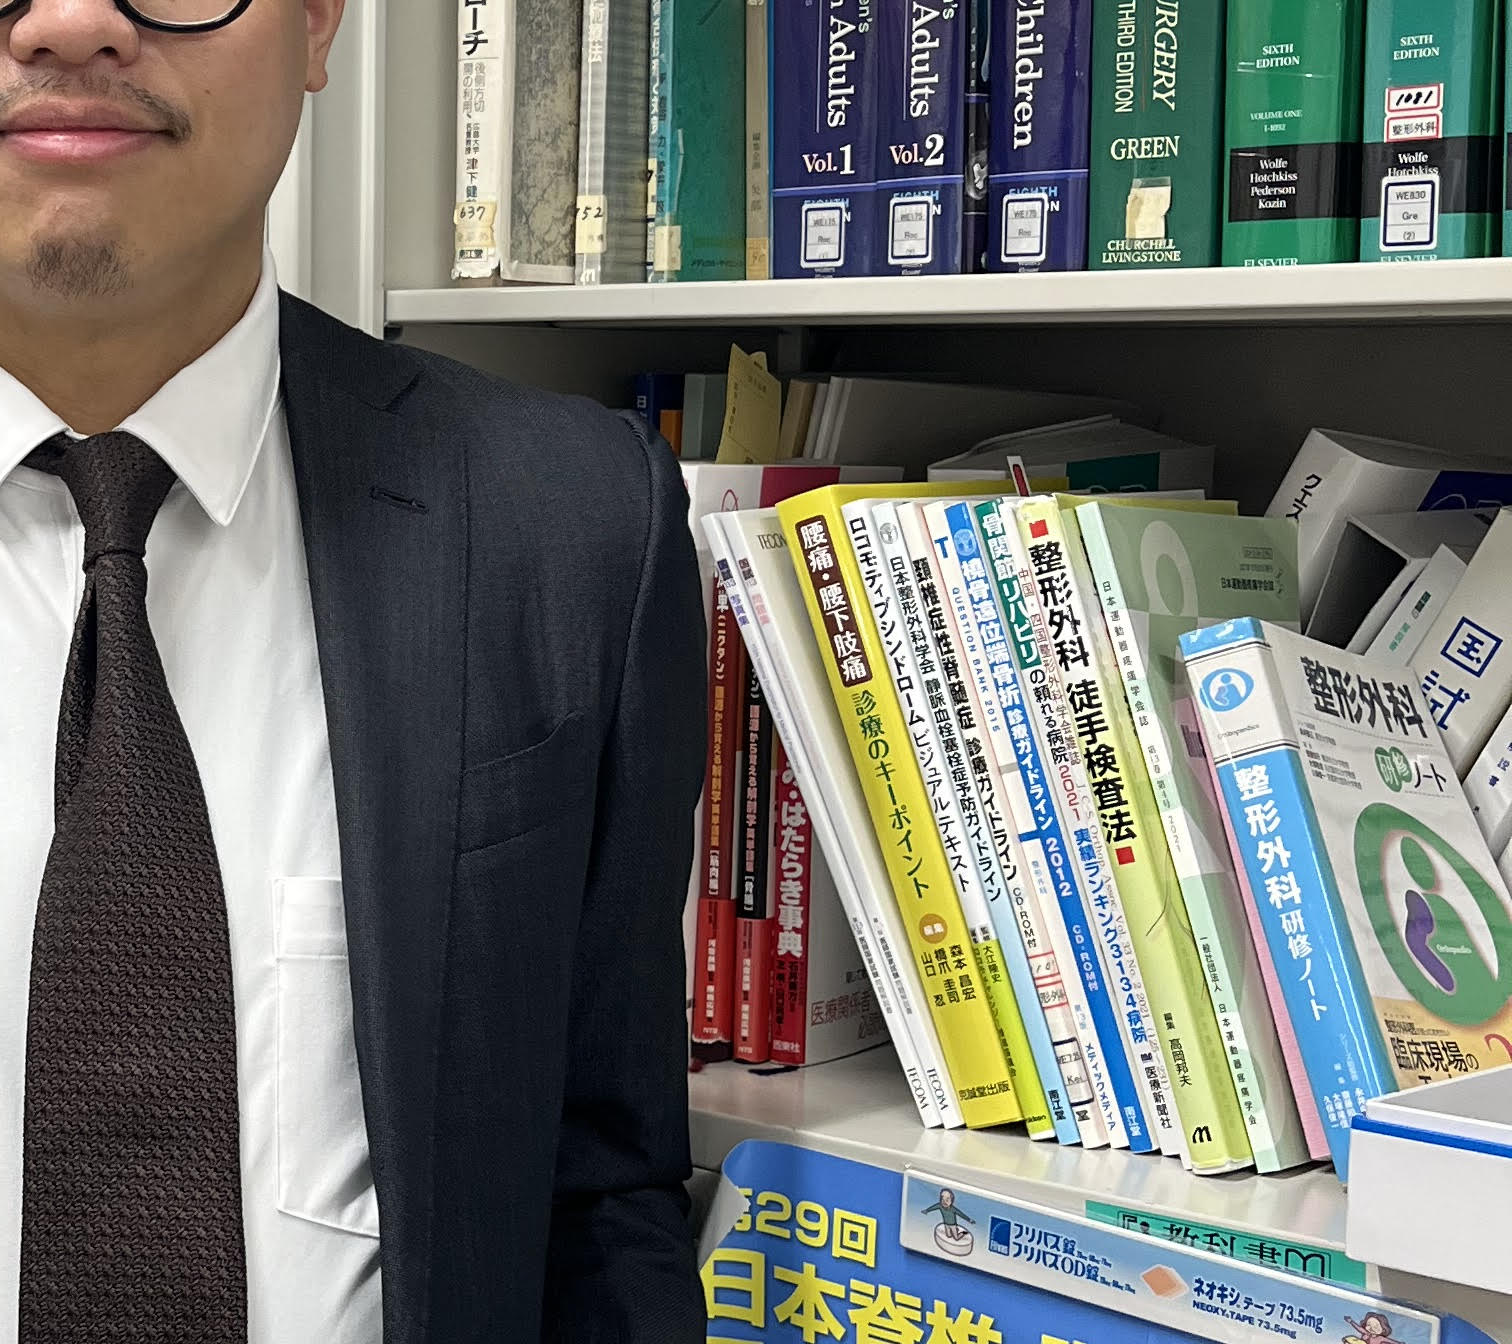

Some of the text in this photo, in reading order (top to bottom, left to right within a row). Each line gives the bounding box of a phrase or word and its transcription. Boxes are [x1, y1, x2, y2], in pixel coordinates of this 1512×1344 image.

[1114, 0, 1136, 113] THIRD EDITION
[1262, 43, 1294, 56] SIXTH
[1393, 46, 1440, 61] EDITION
[1399, 34, 1433, 47] SIXTH
[827, 15, 856, 128] Adults
[909, 1, 940, 118] Adults
[1255, 55, 1300, 69] EDITION
[1391, 121, 1437, 137] 整形外科
[1110, 136, 1180, 161] GREEN
[1259, 158, 1288, 171] Wolfe
[1398, 151, 1428, 164] Wolfe
[1249, 170, 1298, 184] Hotchkiss
[1250, 183, 1296, 197] Pederson
[459, 207, 486, 220] 637
[1257, 197, 1286, 209] Kozin
[1402, 211, 1418, 221] Gre
[1101, 249, 1181, 265] LIVINGSTONE
[1107, 238, 1176, 253] CHURCHILL
[890, 557, 937, 674] 日本整形外科学会
[952, 587, 989, 693] QUESTION BANK
[799, 519, 930, 899] 腰痛・腰下肢痛 診療のキーポイント
[849, 515, 971, 893] ロコモティブシンドローム ビジュアルテキスト
[1028, 540, 1138, 845] 整形外科 徒手検査法
[1300, 656, 1429, 739] 整形外科
[1377, 747, 1447, 792] 研修ノート
[965, 737, 1016, 881] 診療ガイドライン
[1005, 708, 1073, 897] 診療ガイドライン 2012
[1232, 763, 1328, 1023] 整形外科研修ノート
[1390, 1036, 1480, 1073] 臨床現場の
[1086, 1043, 1116, 1131] メディックメディア
[1279, 1302, 1324, 1335] 73.5mg
